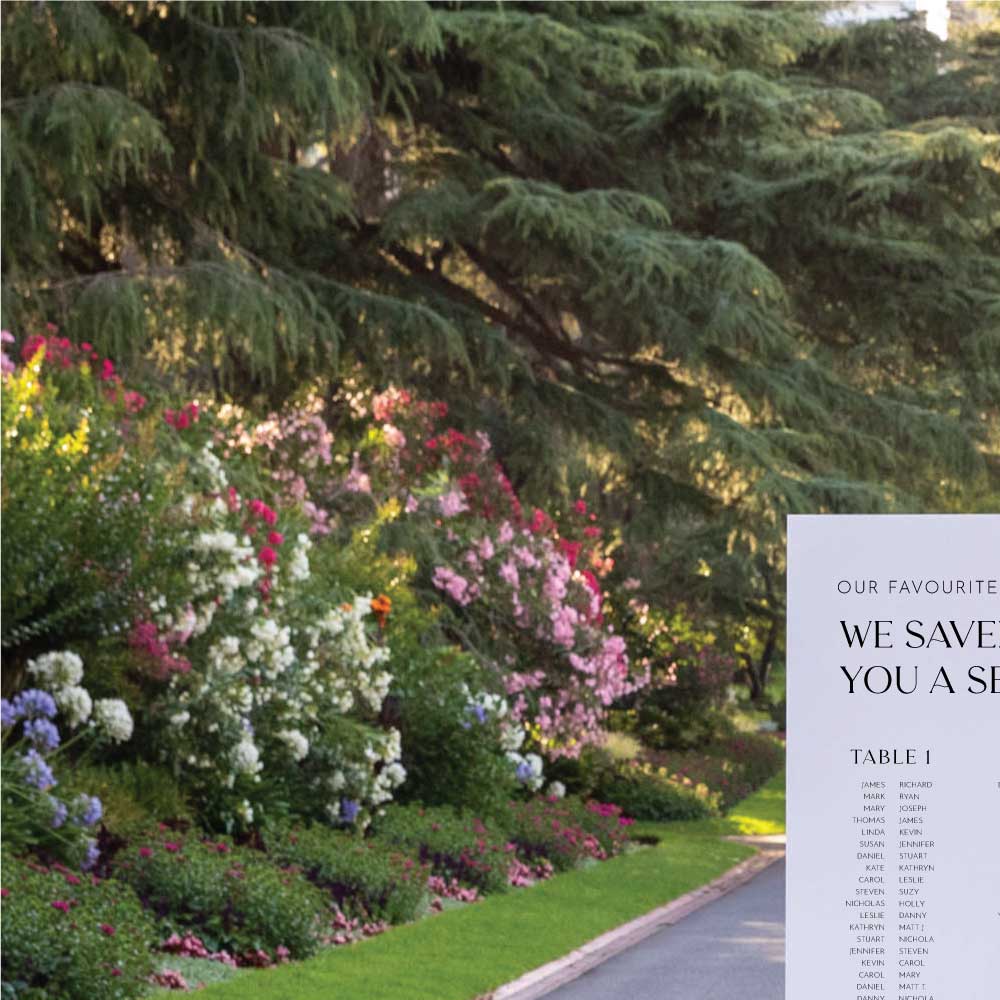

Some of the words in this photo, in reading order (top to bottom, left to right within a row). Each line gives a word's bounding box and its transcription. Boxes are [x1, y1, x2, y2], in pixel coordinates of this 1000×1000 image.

[837, 579, 879, 595] OUR
[888, 579, 998, 596] FAVOURITE
[839, 619, 894, 649] WE
[839, 665, 920, 695] YOU
[928, 665, 957, 694] A
[849, 748, 917, 766] TABLE
[925, 748, 931, 765] 1
[861, 780, 887, 790] JAMES
[899, 780, 933, 790] RICHARD
[863, 792, 886, 800] MARK
[899, 792, 920, 801] RYAN
[863, 804, 886, 813] MARY
[898, 804, 927, 813] JOSEPH
[851, 815, 886, 824] THOMAS
[898, 816, 924, 825] JAMES
[861, 828, 886, 837] LINDA
[899, 828, 923, 837] KEVIN
[858, 840, 885, 848] SUSAN
[898, 839, 936, 849] JENNIFER
[856, 851, 885, 860] DANIEL
[899, 851, 928, 861] STUART
[865, 864, 885, 872] KATE
[898, 864, 935, 873] KATHRYN
[858, 874, 885, 885] CAROL
[898, 876, 925, 884] LESLIE
[855, 887, 885, 896] STEVEN
[898, 888, 920, 896] SUZY
[845, 898, 886, 908] NICHOLAS
[898, 899, 926, 908] HOLLY
[859, 911, 885, 919] LESLIE
[898, 911, 928, 921] DANNY
[849, 923, 885, 932] KATHRYN
[898, 923, 919, 933] MATT
[856, 935, 886, 943] STUART
[898, 935, 935, 944] NICHOLA
[849, 947, 886, 956] JENNIFER
[898, 947, 929, 955] STEVEN
[861, 959, 886, 968] KEVIN
[898, 959, 926, 967] CAROL
[858, 970, 886, 979] CAROL
[898, 971, 921, 979] MARY
[856, 983, 885, 992] DANIEL
[897, 983, 919, 992] MATT
